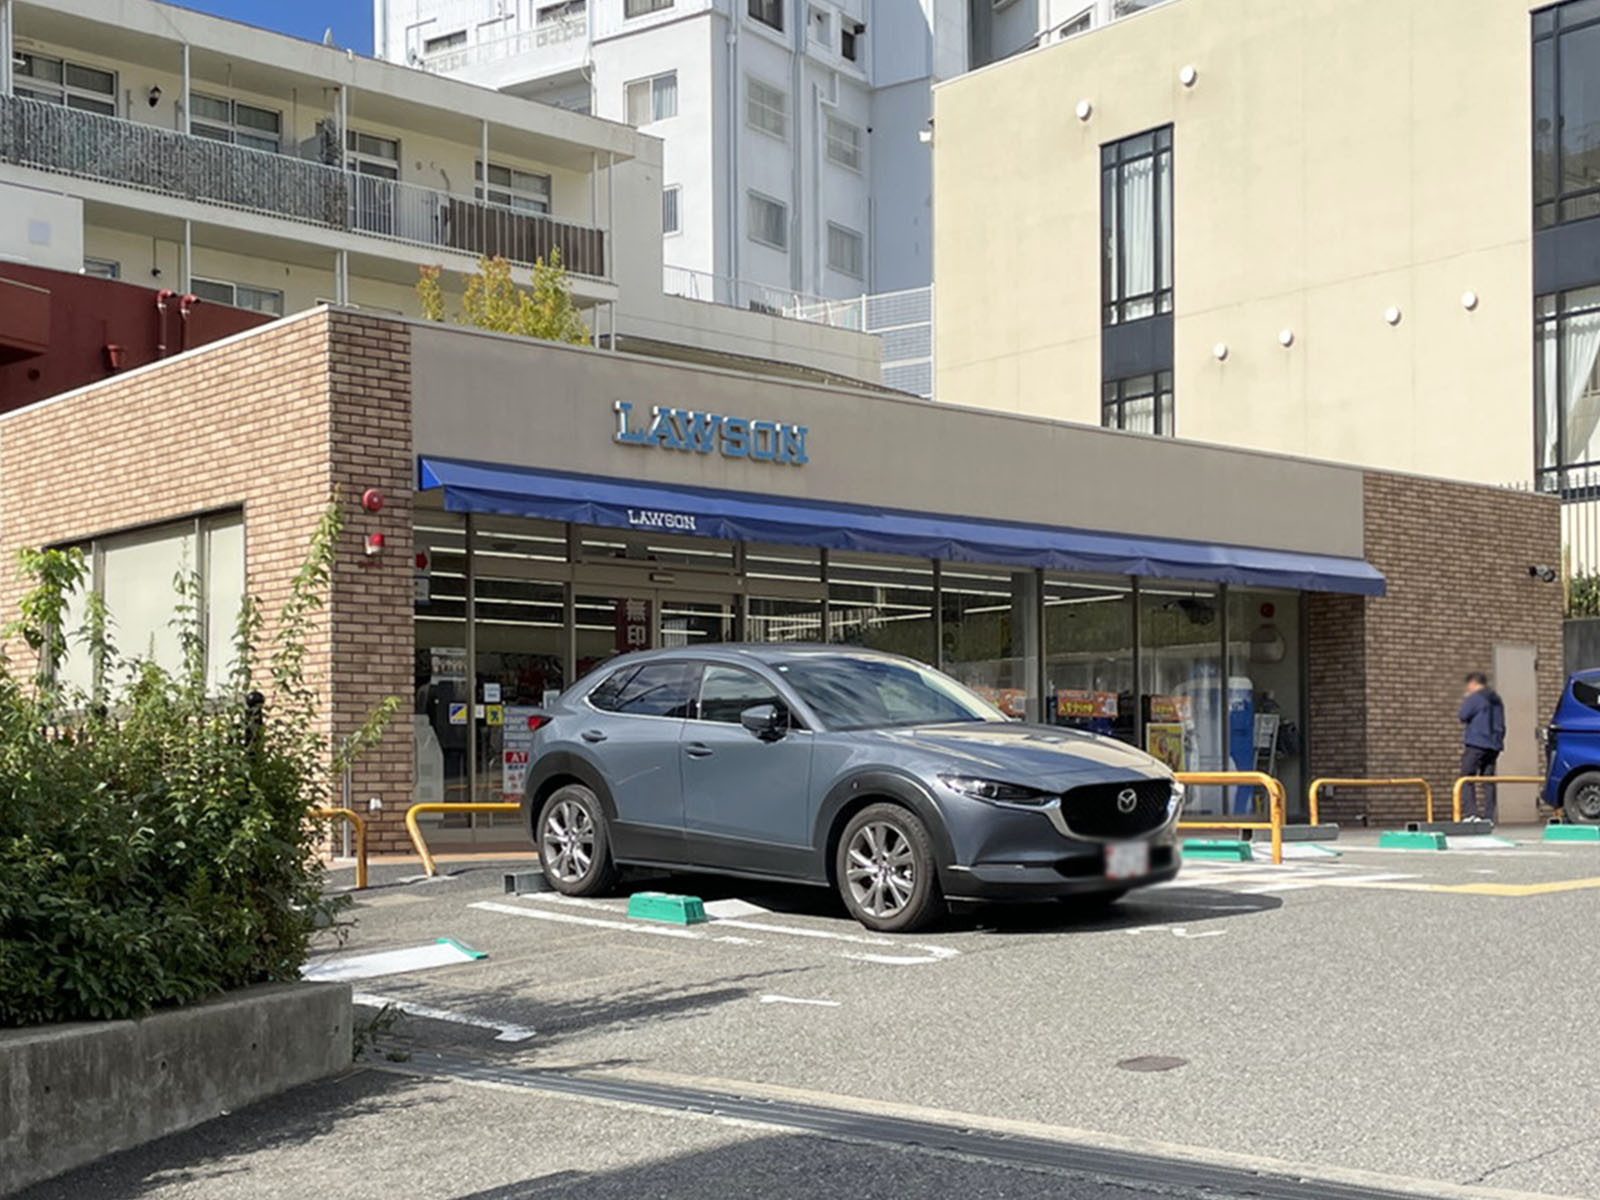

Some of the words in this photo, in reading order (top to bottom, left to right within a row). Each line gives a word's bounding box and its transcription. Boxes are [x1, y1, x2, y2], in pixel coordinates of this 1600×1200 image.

[613, 400, 809, 466] LAWSON
[627, 509, 696, 531] LAWSON
[626, 600, 646, 650] 無印
[510, 752, 528, 762] AT
